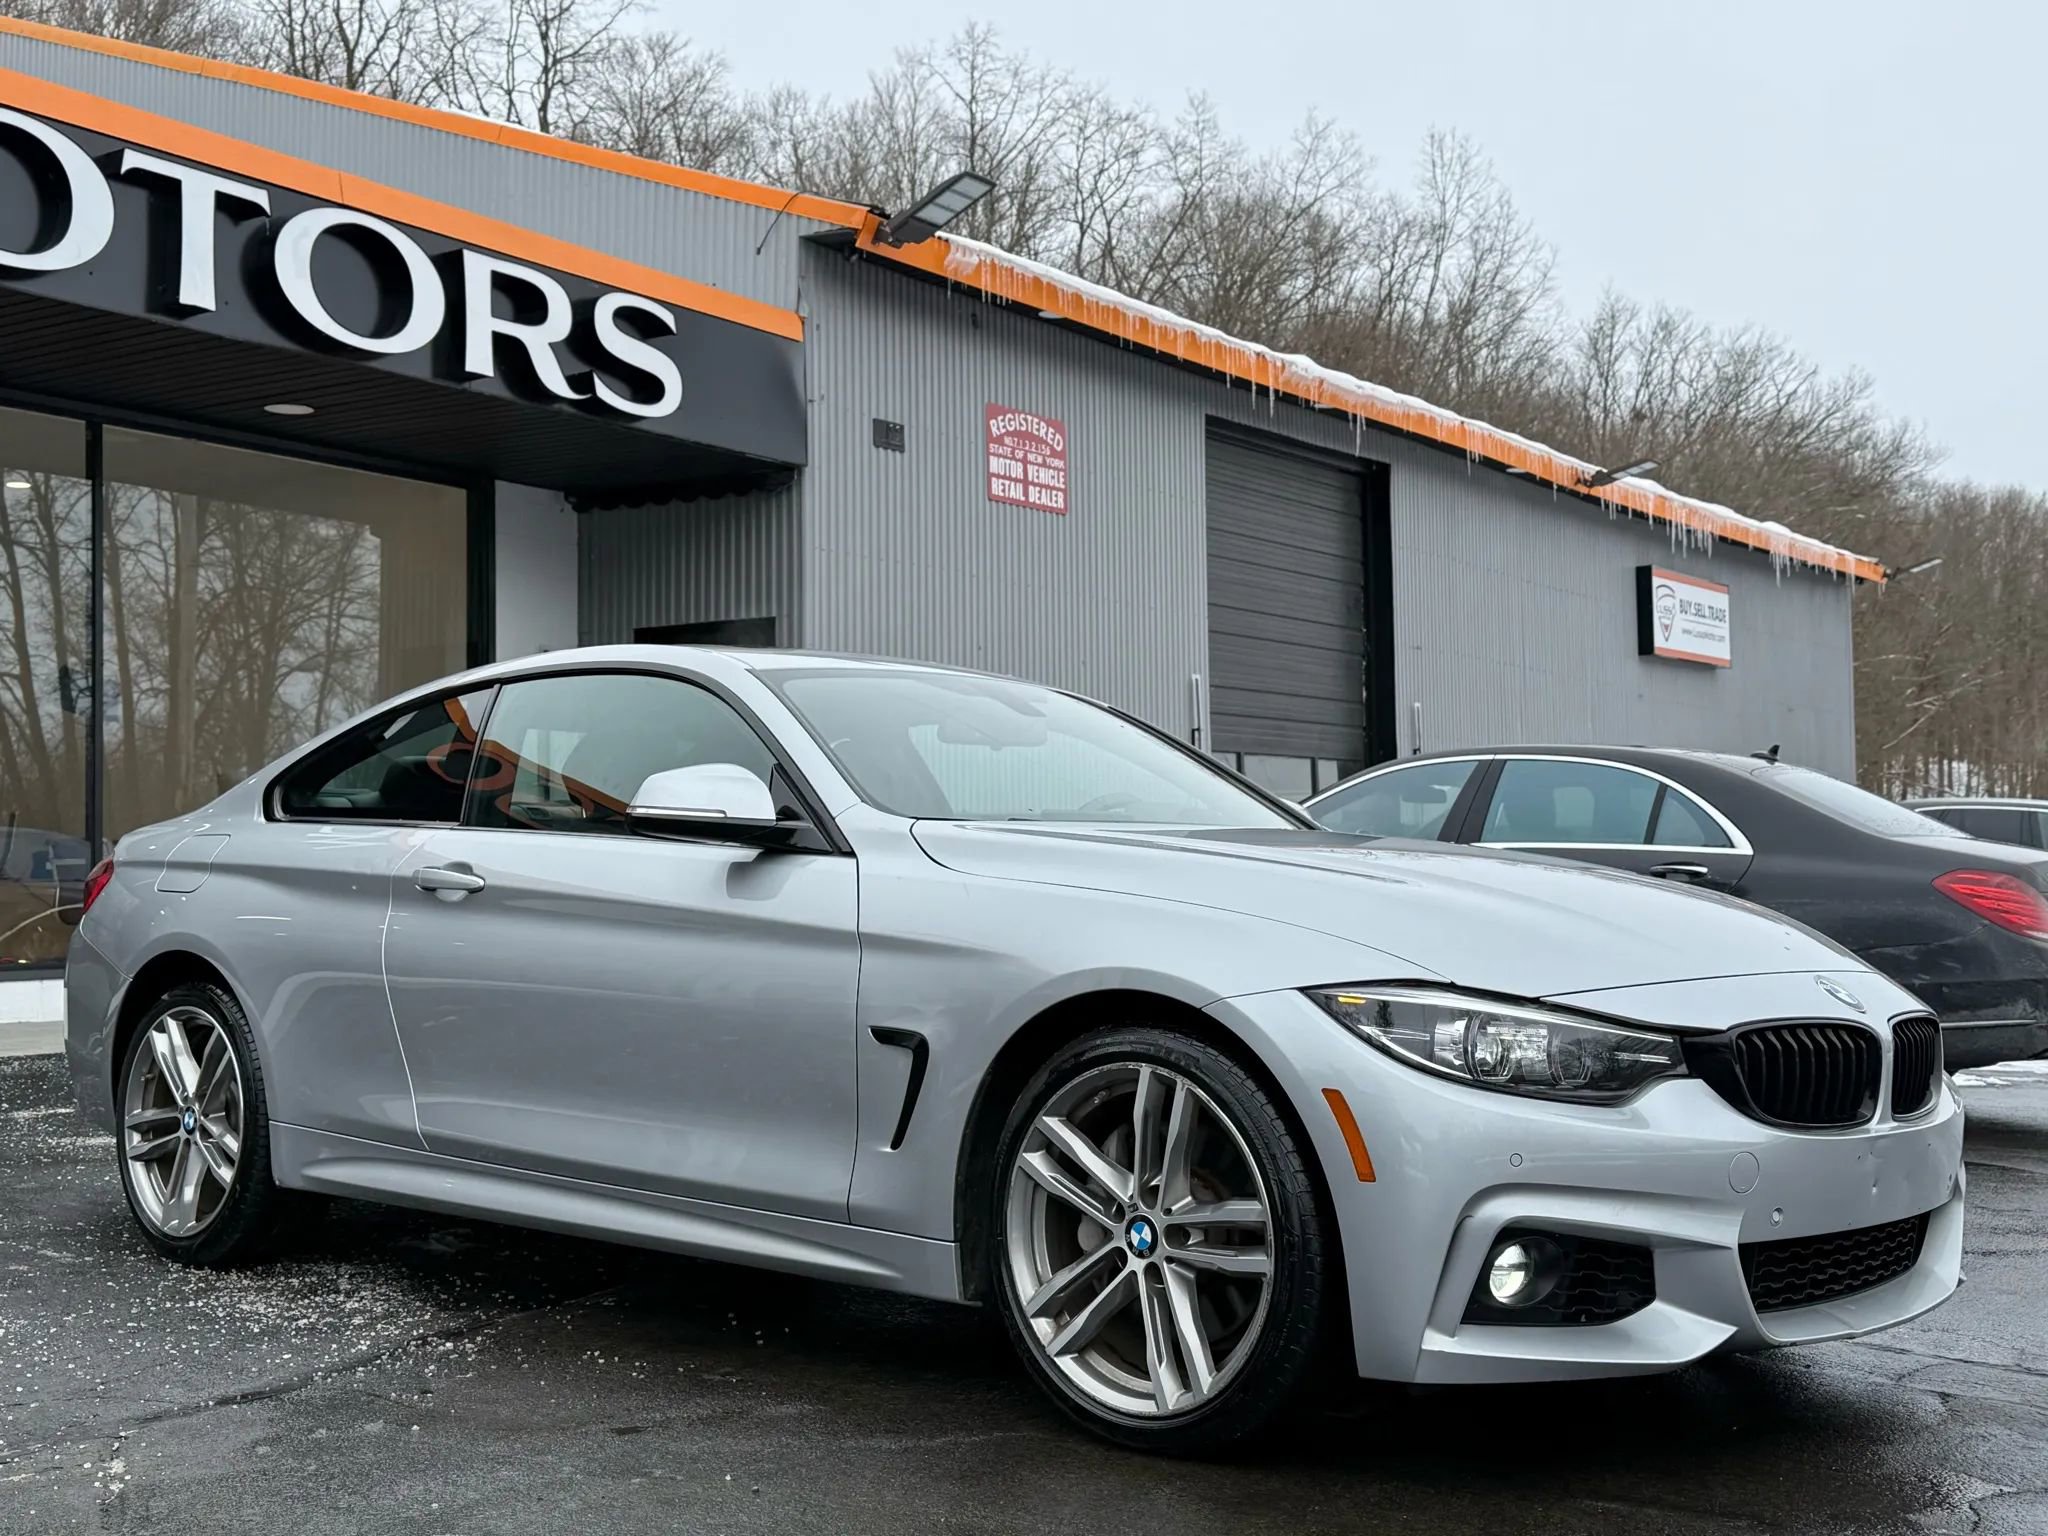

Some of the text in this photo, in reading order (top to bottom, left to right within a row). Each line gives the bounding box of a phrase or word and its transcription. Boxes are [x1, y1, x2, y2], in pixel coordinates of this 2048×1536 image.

[989, 413, 1063, 451] REGISTERED
[989, 443, 1065, 469] STATE OF NEW YORK
[989, 455, 1065, 489] MOTOR VEHICLE
[991, 477, 1064, 509] RETAIL DEALER
